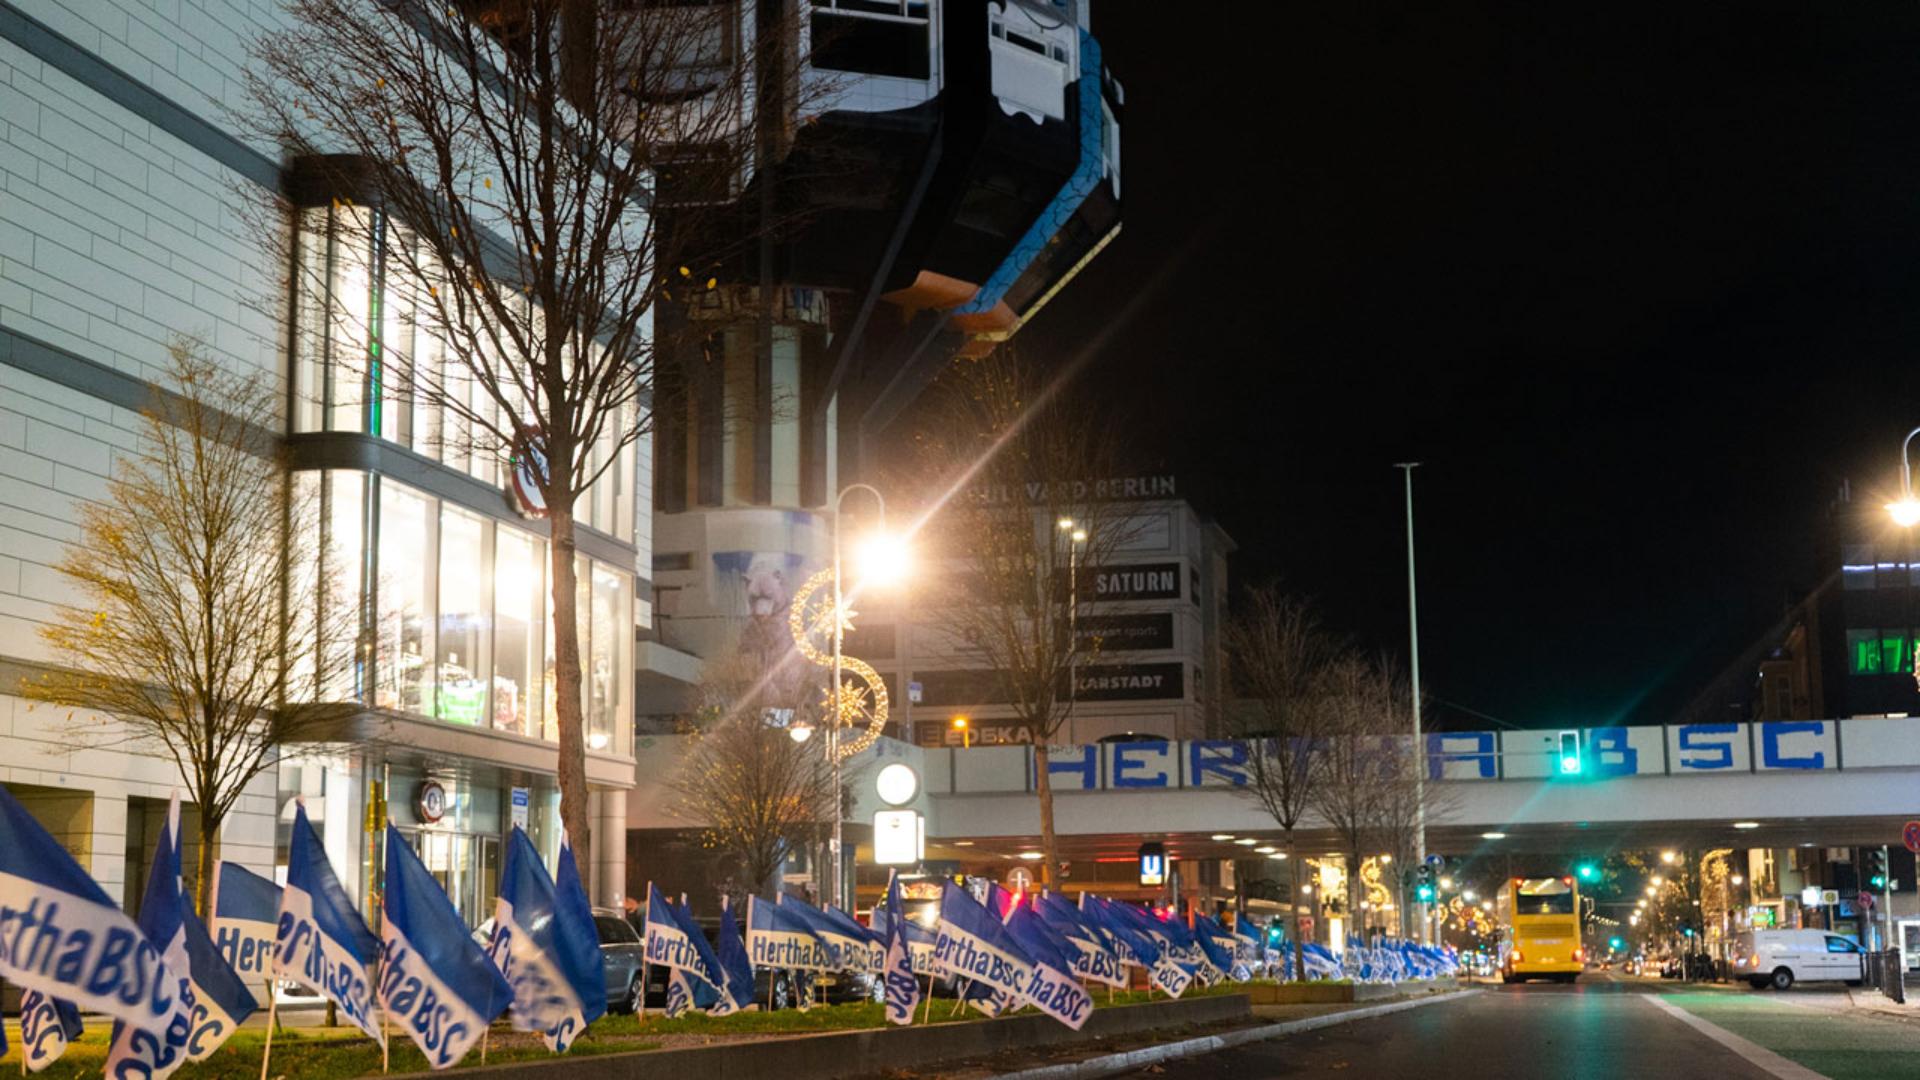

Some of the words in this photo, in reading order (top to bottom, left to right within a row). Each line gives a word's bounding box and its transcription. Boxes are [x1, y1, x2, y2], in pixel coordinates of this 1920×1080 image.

[1096, 475, 1176, 499] BERLIN
[1097, 571, 1175, 593] SATURN
[1590, 721, 1825, 777] BSC
[1143, 855, 1160, 875] U
[217, 927, 278, 973] Her
[1075, 950, 1124, 983] aBSC
